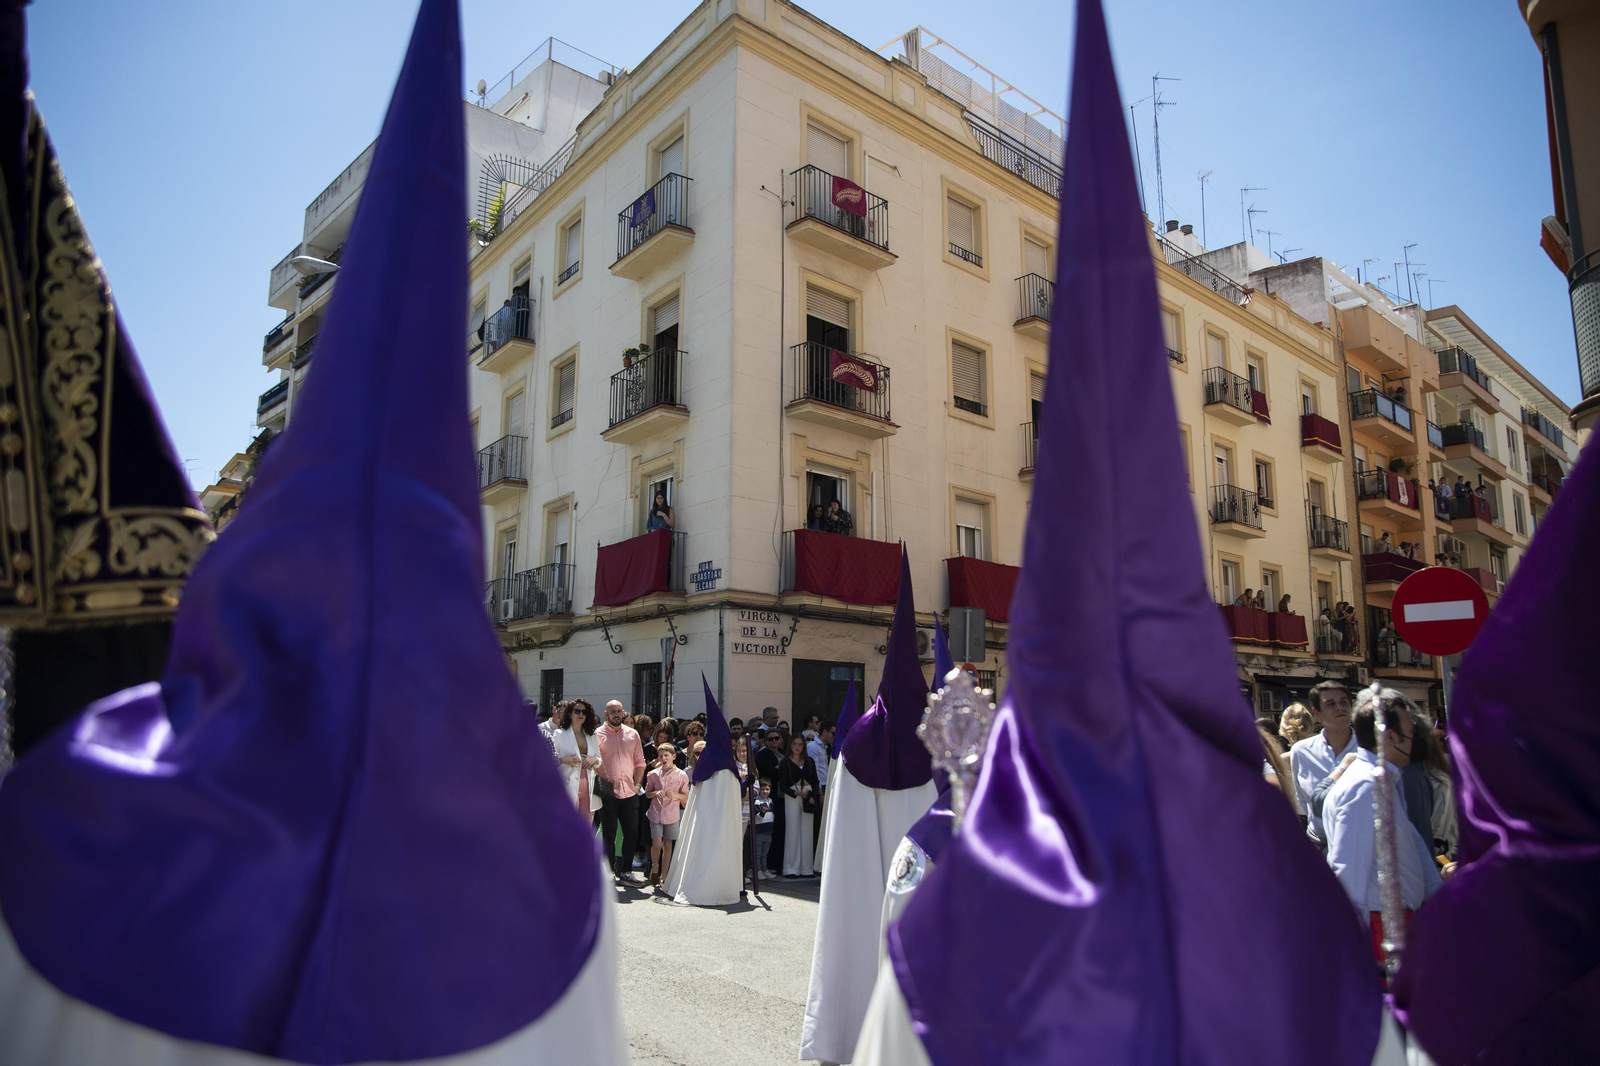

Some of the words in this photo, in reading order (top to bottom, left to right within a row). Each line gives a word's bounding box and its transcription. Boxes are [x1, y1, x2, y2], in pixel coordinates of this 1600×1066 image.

[695, 580, 715, 590] ELCANO
[740, 611, 780, 622] VIRGEN
[743, 627, 756, 635] DE
[763, 628, 777, 637] LA
[734, 643, 786, 654] VICTORIA
